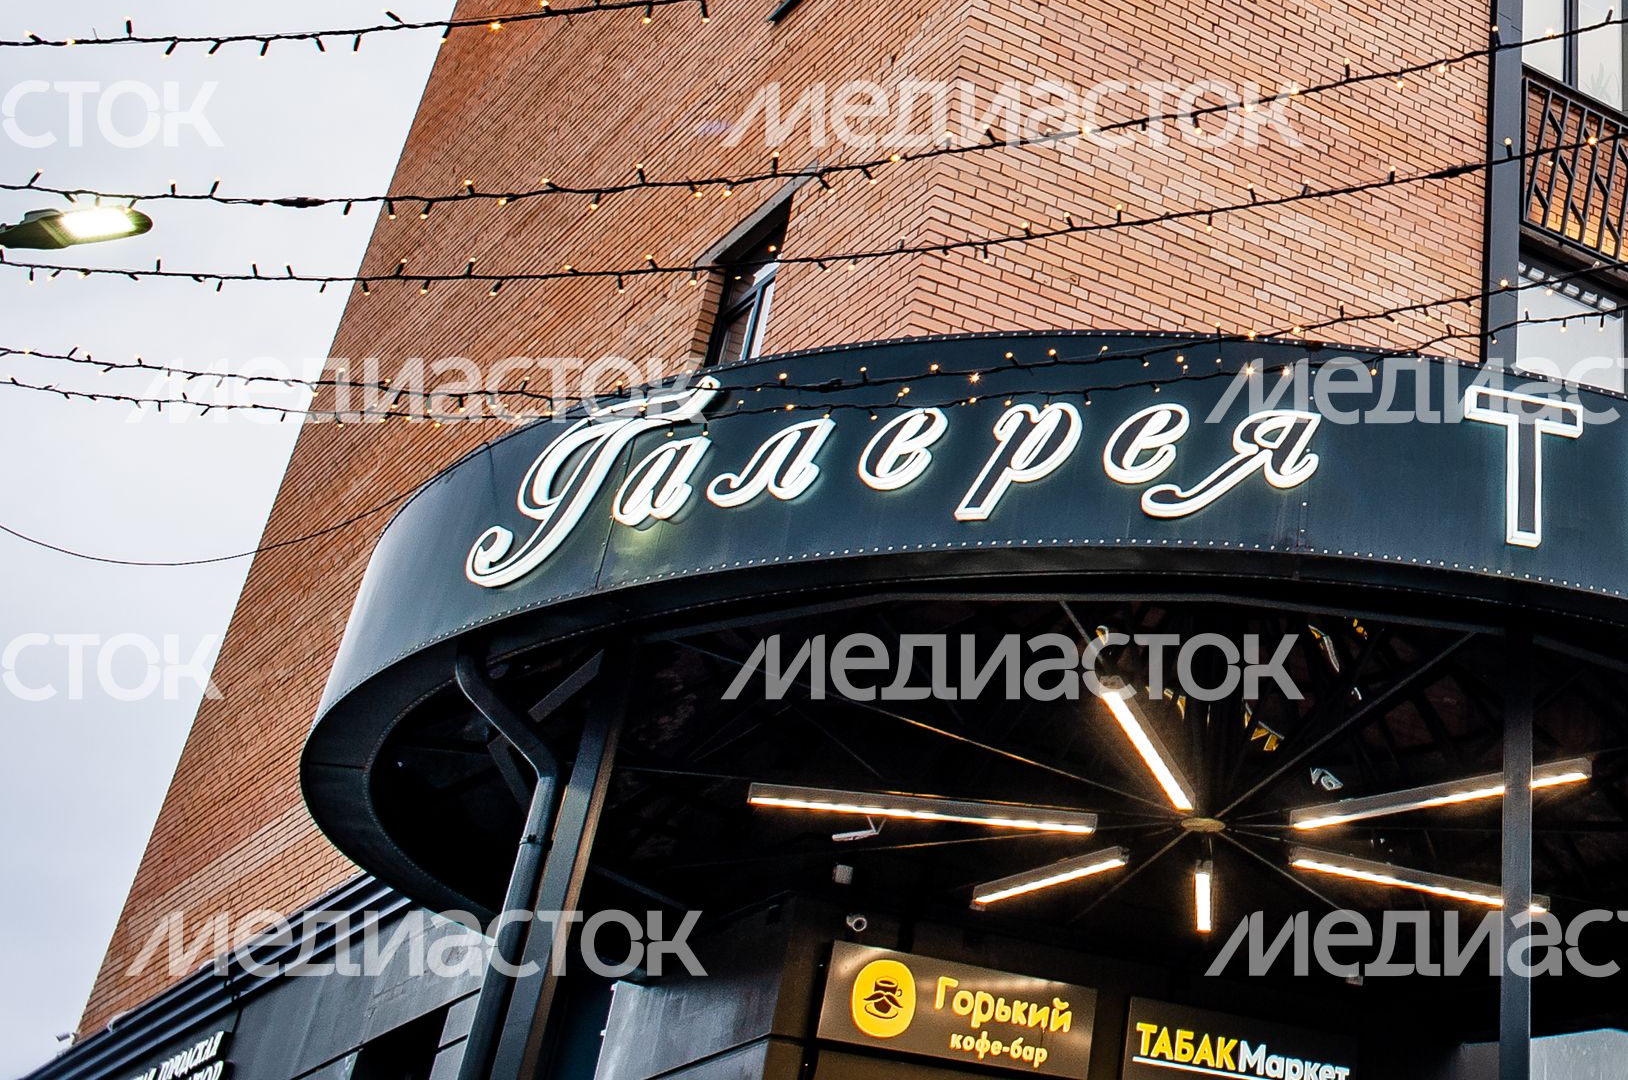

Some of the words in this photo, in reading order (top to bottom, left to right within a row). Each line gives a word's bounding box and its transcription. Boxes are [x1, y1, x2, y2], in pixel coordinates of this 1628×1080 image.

[465, 375, 1319, 587] Галерея
[934, 975, 1073, 1034] Горький
[949, 1031, 1049, 1068] кофе-бар
